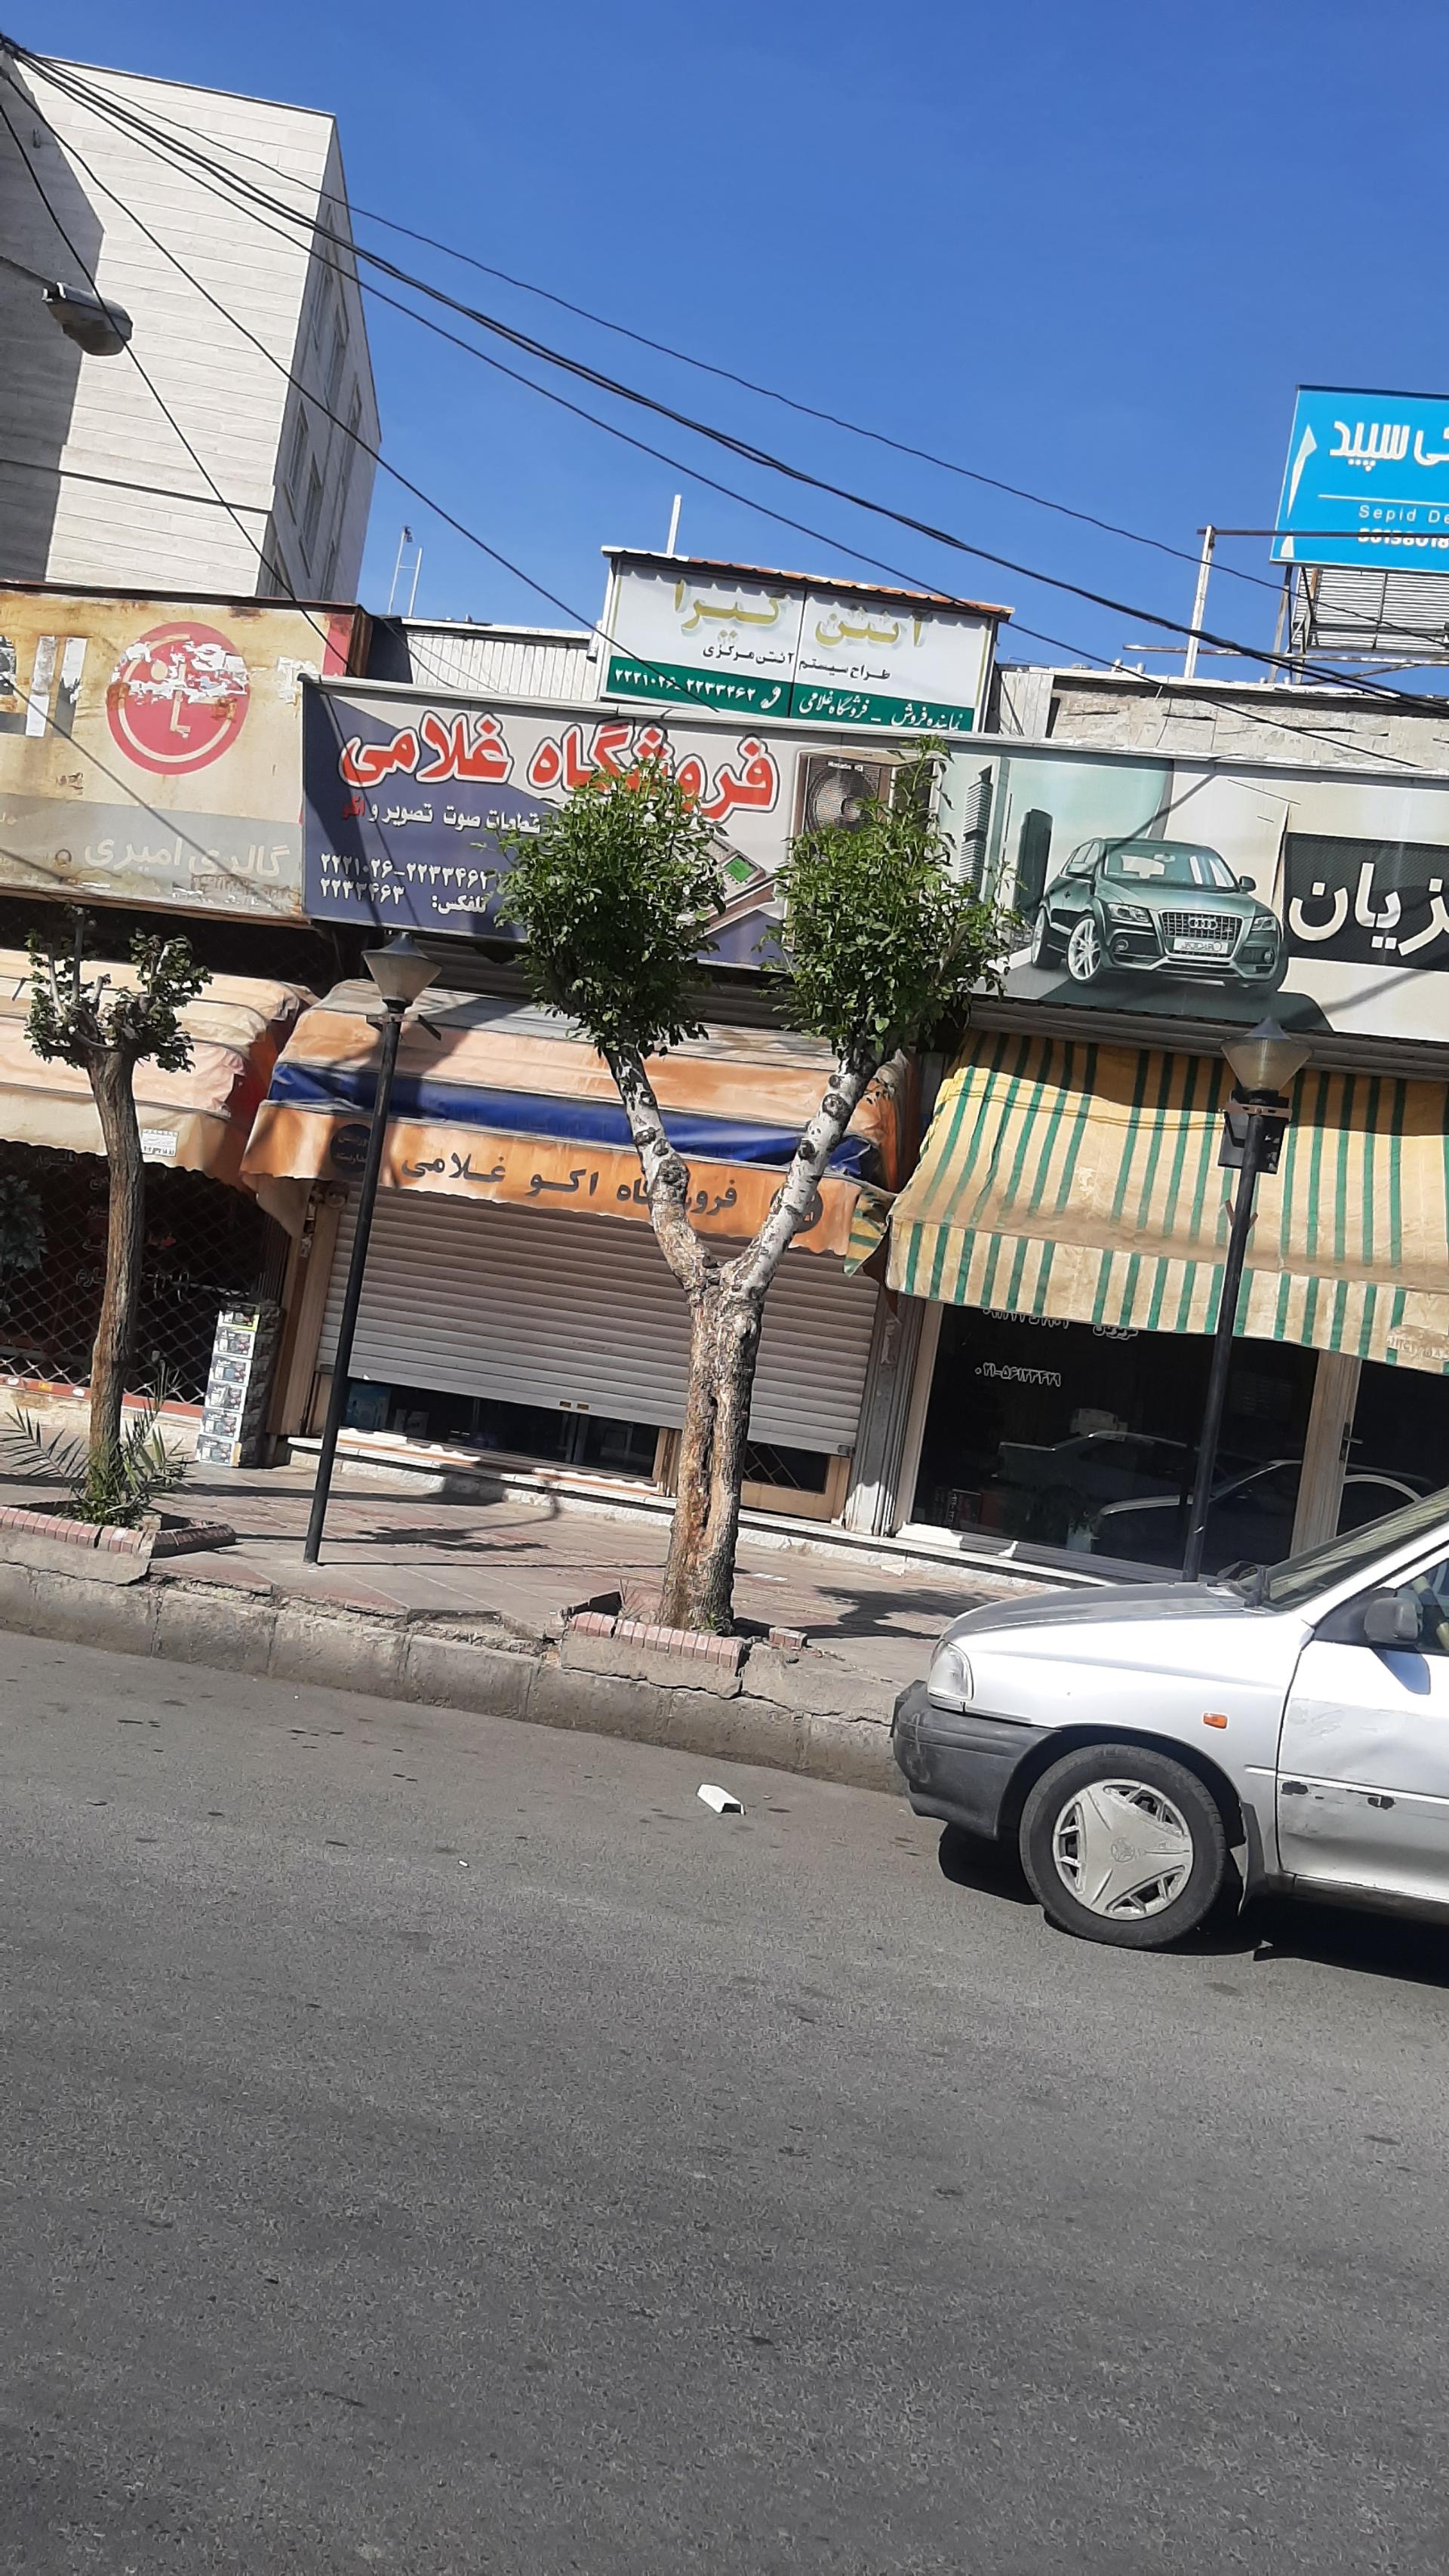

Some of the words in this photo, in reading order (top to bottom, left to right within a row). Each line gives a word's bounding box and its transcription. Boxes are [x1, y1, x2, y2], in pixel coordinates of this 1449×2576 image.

[1329, 420, 1410, 472] سپید
[1358, 504, 1417, 523] Sepid
[703, 644, 755, 661] مرکزی
[755, 651, 795, 665] آنتن
[798, 659, 848, 676] سیستم
[850, 664, 891, 681] طراح
[799, 690, 833, 714] غلامی
[891, 703, 928, 726] فروش
[340, 712, 512, 786] غلامی
[369, 804, 378, 822] و
[382, 802, 433, 825] تصویر
[443, 805, 481, 831] صوت
[85, 837, 183, 872] امیری
[320, 877, 405, 905] ۲۲۳۳۴۶۳
[401, 1152, 506, 1183] غلامی
[525, 1169, 599, 1197] اکو
